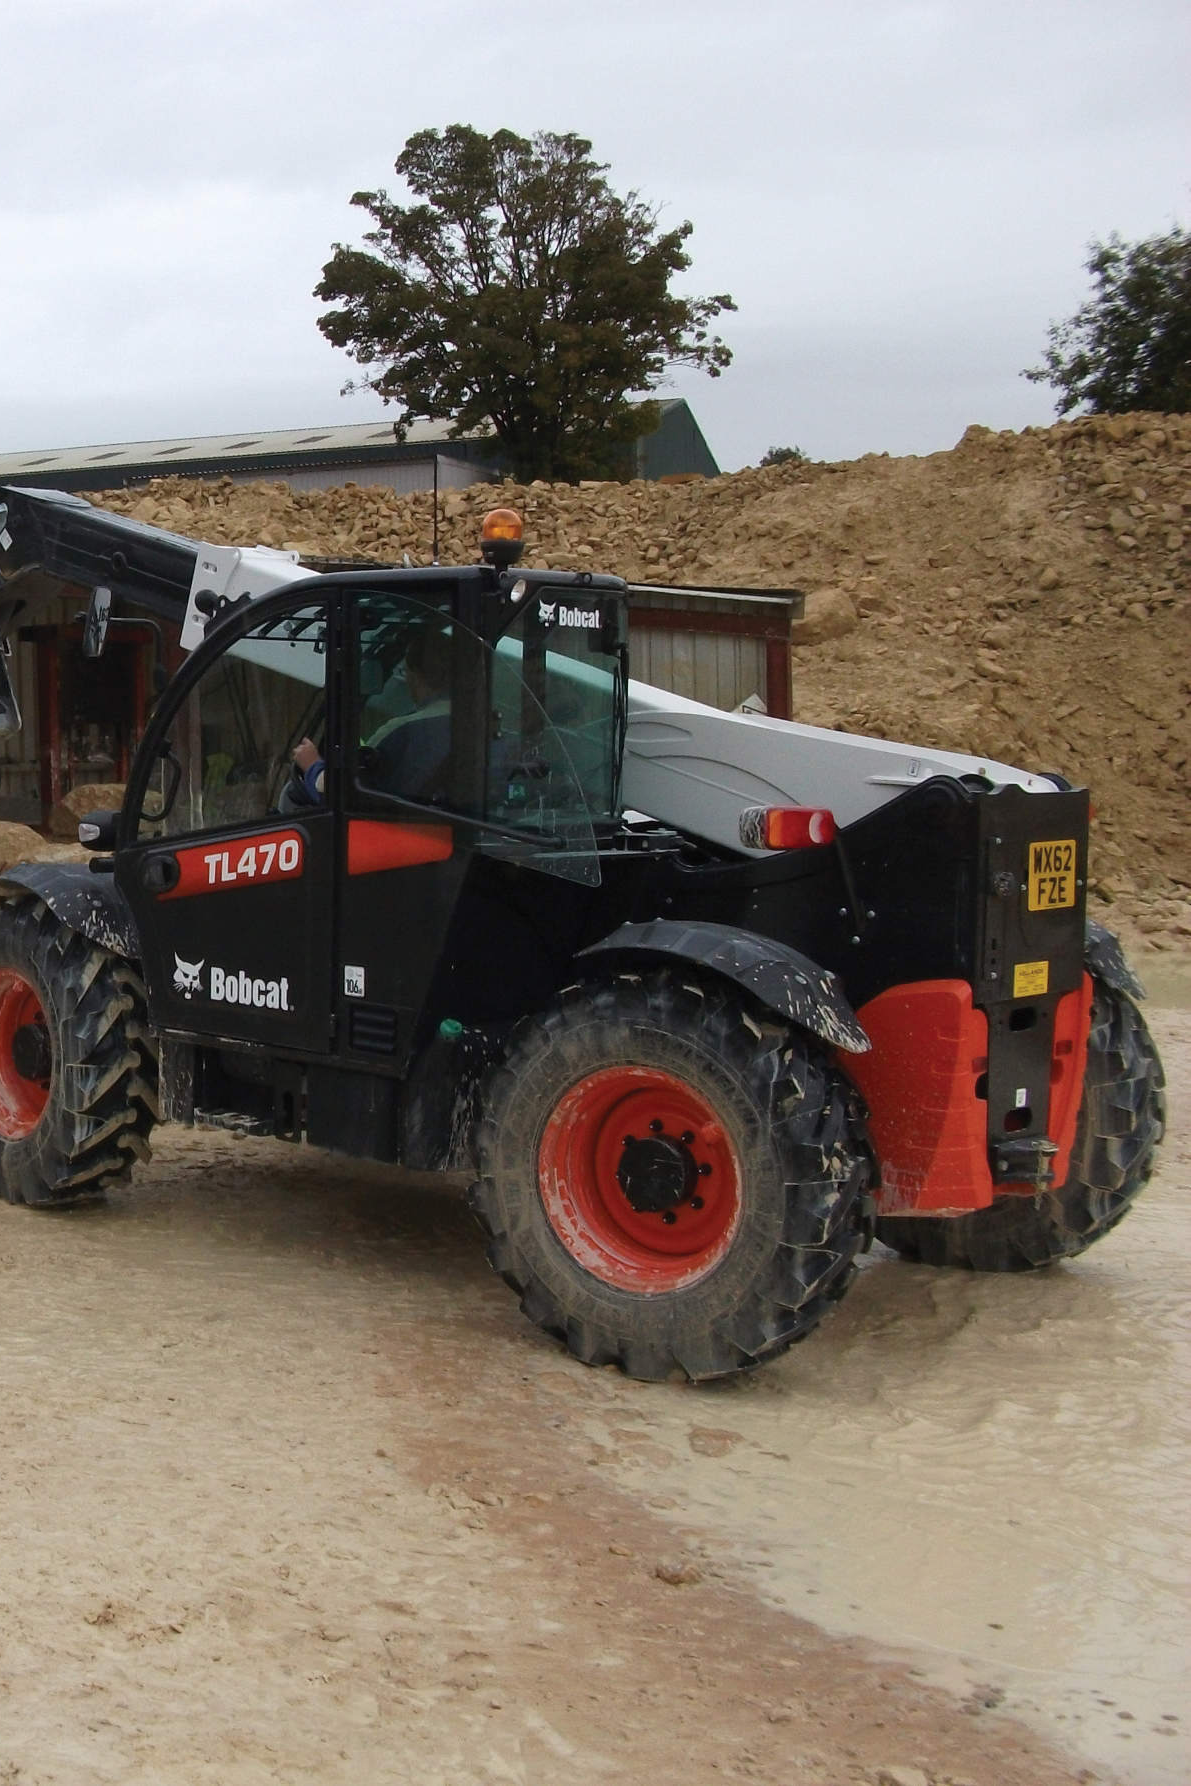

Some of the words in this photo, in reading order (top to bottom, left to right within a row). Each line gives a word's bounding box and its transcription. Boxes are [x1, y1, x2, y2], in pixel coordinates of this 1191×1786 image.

[559, 606, 600, 629] Bobcat
[204, 839, 299, 884] TL470
[1033, 845, 1072, 874] WX62
[1037, 876, 1067, 905] FZE
[210, 966, 290, 1011] Bobcat
[345, 979, 358, 993] 106
